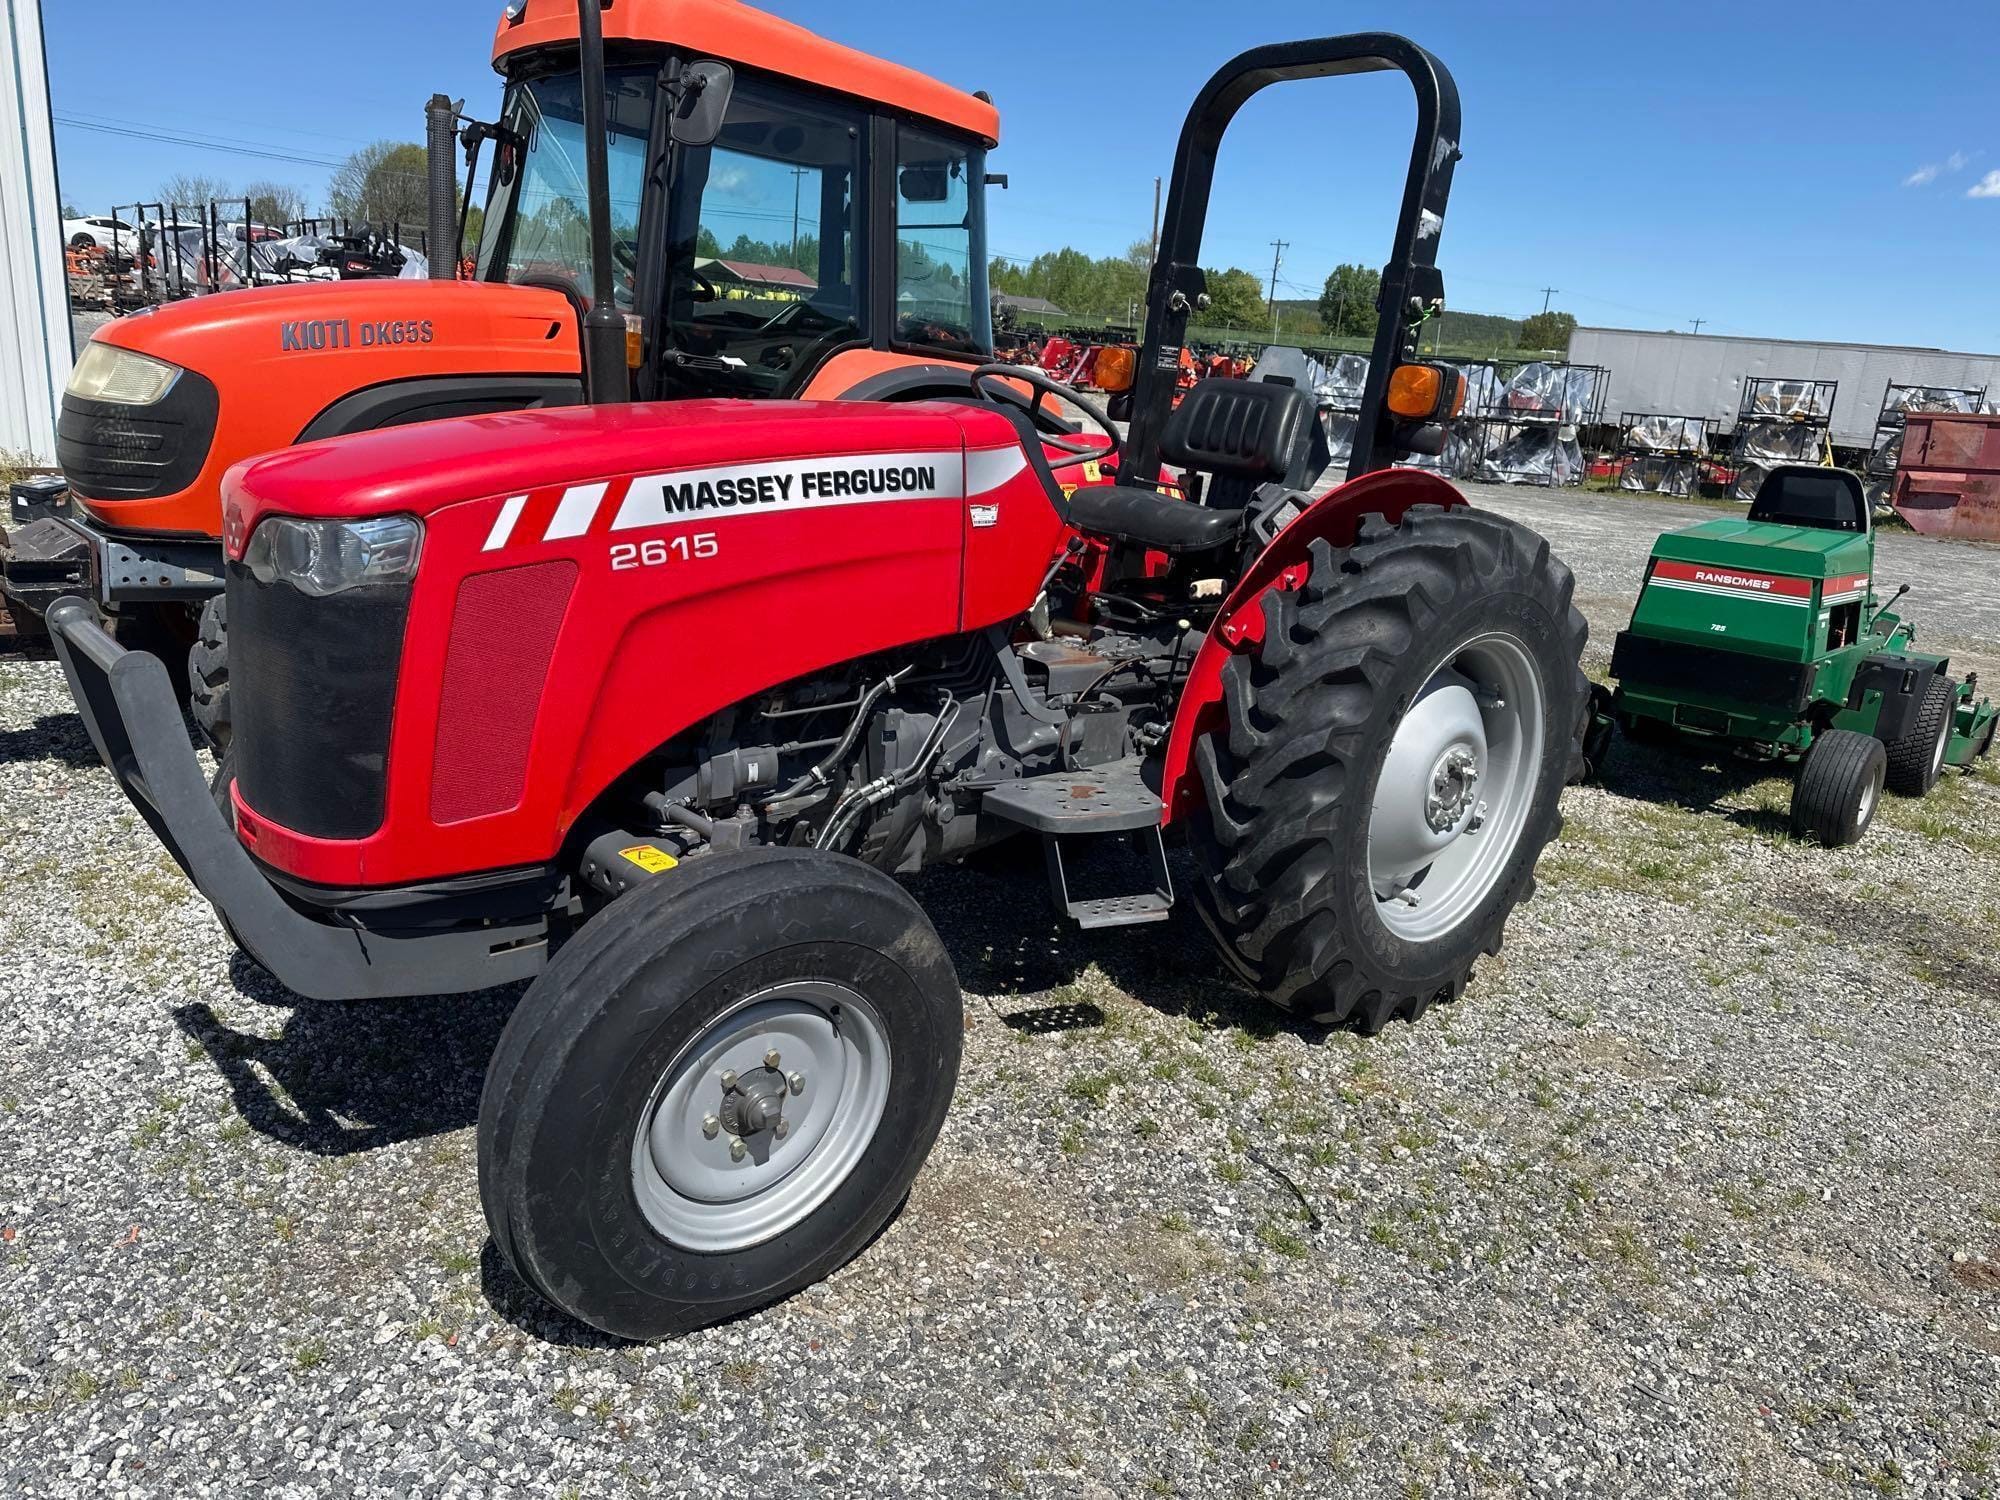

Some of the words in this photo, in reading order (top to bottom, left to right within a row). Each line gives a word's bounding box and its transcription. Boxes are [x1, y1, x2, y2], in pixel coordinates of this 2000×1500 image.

[282, 319, 350, 351] KIOTI
[360, 320, 434, 346] DK65S
[662, 474, 793, 513] MASSEY
[801, 467, 935, 499] FERGUSON
[610, 532, 719, 571] 2615
[1695, 571, 1771, 590] RANSOMES
[1710, 623, 1727, 632] 725
